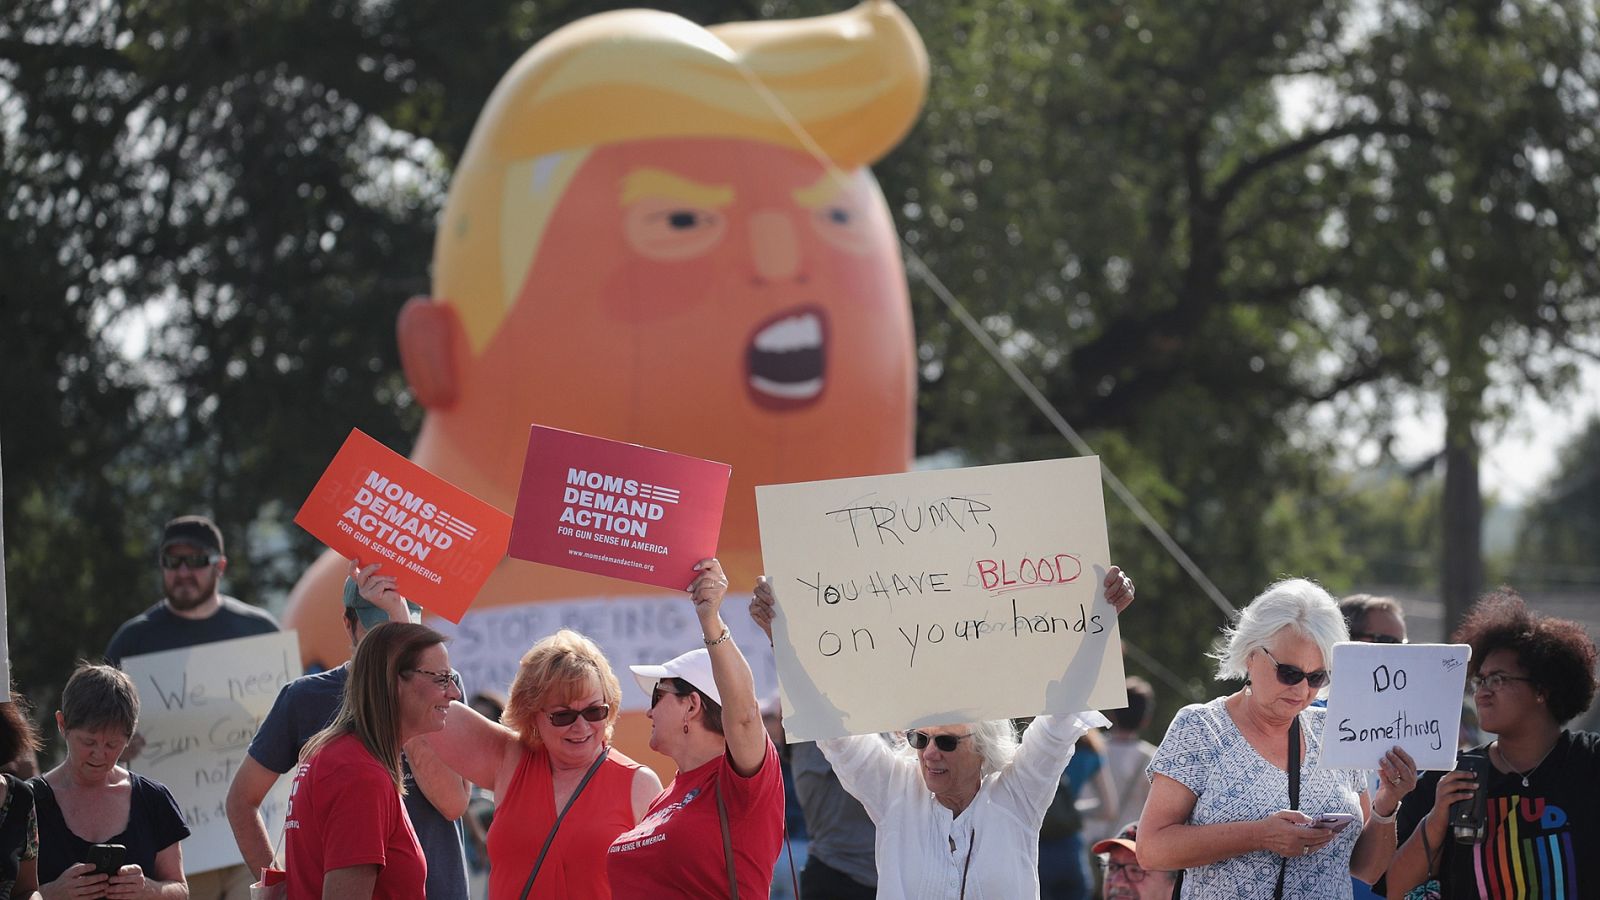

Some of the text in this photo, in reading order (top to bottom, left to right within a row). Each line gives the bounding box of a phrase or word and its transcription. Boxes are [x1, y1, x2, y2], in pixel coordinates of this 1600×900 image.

[365, 470, 438, 520] MOMS
[563, 487, 664, 521] DEMAND
[566, 467, 639, 497] MOMS
[342, 505, 431, 561] ACTION
[354, 487, 453, 550] DEMAND
[557, 526, 669, 555] FOR GUN SENSE IN AMERICA
[559, 506, 648, 538] ACTION
[825, 496, 998, 548] TRUMP,
[336, 519, 442, 584] FOR GUN SENSE IN AMERICA
[568, 548, 655, 572] www.momsdemandaction.org
[869, 570, 951, 600] HAVE
[976, 554, 1082, 589] BLOOD
[818, 598, 1104, 668] on your hands
[149, 648, 291, 711] We need
